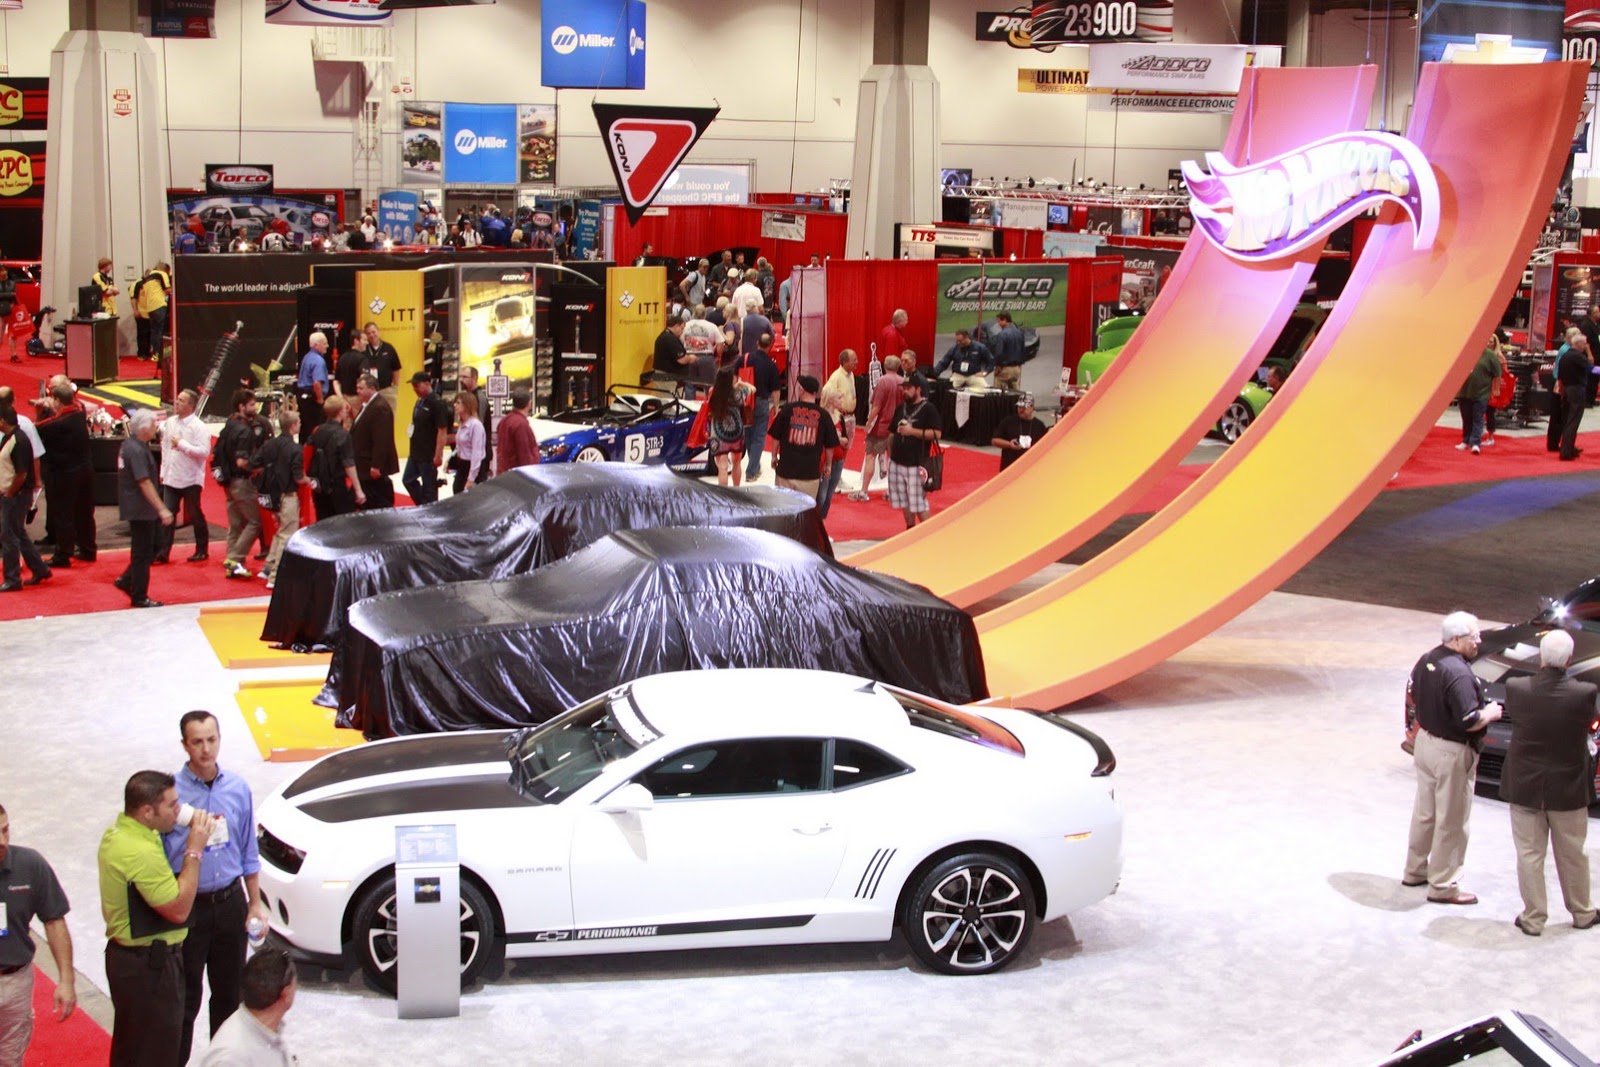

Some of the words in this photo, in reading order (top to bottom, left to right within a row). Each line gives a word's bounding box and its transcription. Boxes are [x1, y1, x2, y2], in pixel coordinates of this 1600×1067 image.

[1064, 2, 1137, 37] 23900
[579, 34, 615, 47] Miller
[1127, 70, 1169, 79] PERFORMANCE
[1035, 84, 1064, 92] POWER
[1110, 97, 1176, 108] PERFORMANCE
[478, 136, 507, 149] Miller
[613, 132, 631, 173] KONI
[215, 171, 268, 182] Torco
[312, 213, 329, 222] Torco
[533, 214, 551, 222] Torco
[911, 229, 936, 242] TTS
[205, 284, 220, 292] The
[220, 283, 243, 292] world
[244, 283, 268, 292] leader
[270, 283, 278, 291] in
[945, 276, 1055, 299] ADDCO
[638, 302, 660, 315] ITT
[950, 301, 1003, 312] PERFORMANCE
[1005, 301, 1025, 311] SWAY
[1026, 301, 1046, 311] BARS
[391, 308, 415, 322] ITT
[630, 438, 640, 461] 5
[646, 436, 664, 450] STR-3
[577, 926, 658, 940] PERFORMANCE
